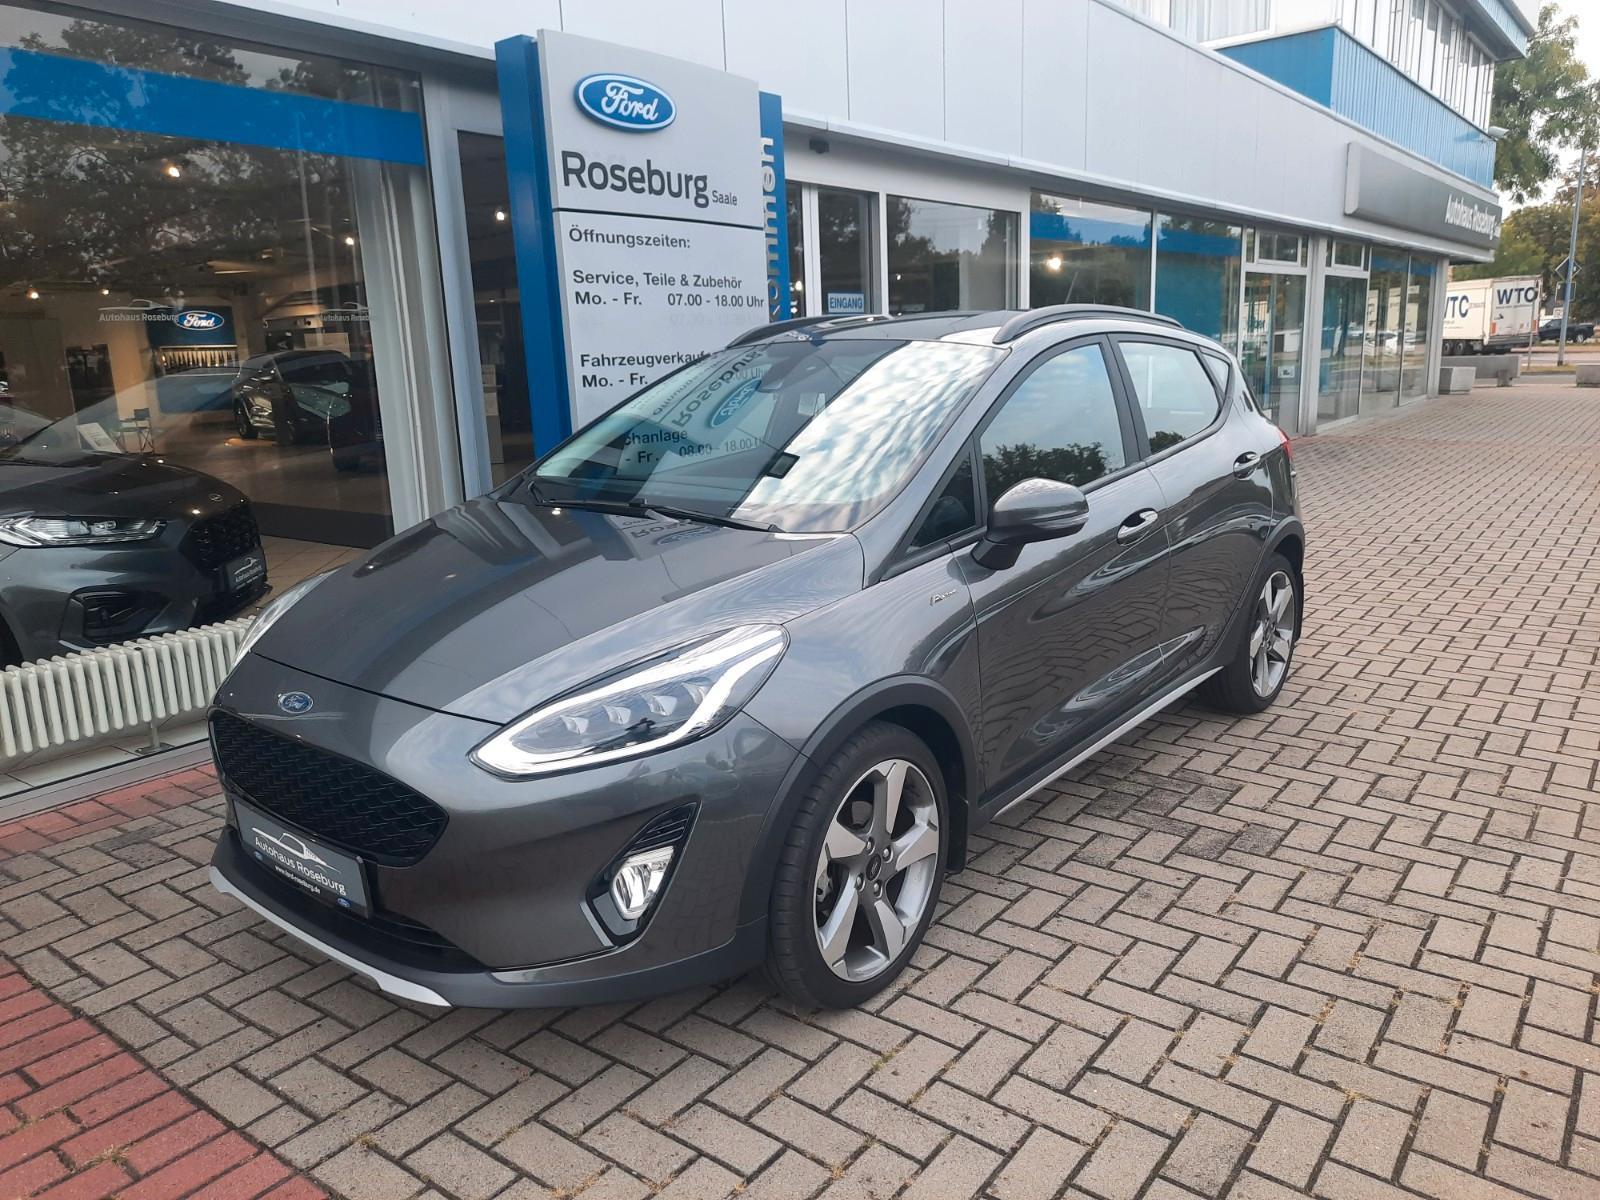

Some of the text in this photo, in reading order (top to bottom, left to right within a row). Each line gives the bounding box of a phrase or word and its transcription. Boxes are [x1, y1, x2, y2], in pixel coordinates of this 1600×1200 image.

[601, 82, 659, 121] Ford
[561, 149, 738, 209] Roseburg Saale
[568, 224, 691, 249] Öffnungszeiten:
[572, 269, 743, 289] Service, Teile & Zubehör
[574, 291, 608, 305] Mo.
[623, 292, 643, 305] Fr.
[667, 293, 702, 306] 07.00
[714, 295, 744, 307] 18.00
[746, 296, 765, 308] Uhr
[829, 297, 864, 310] EINGANG
[99, 313, 141, 322] Autohaus
[183, 313, 216, 328] Ford
[582, 374, 614, 388] Mo.
[629, 372, 649, 386] Fr.
[296, 861, 346, 896] Roseburg
